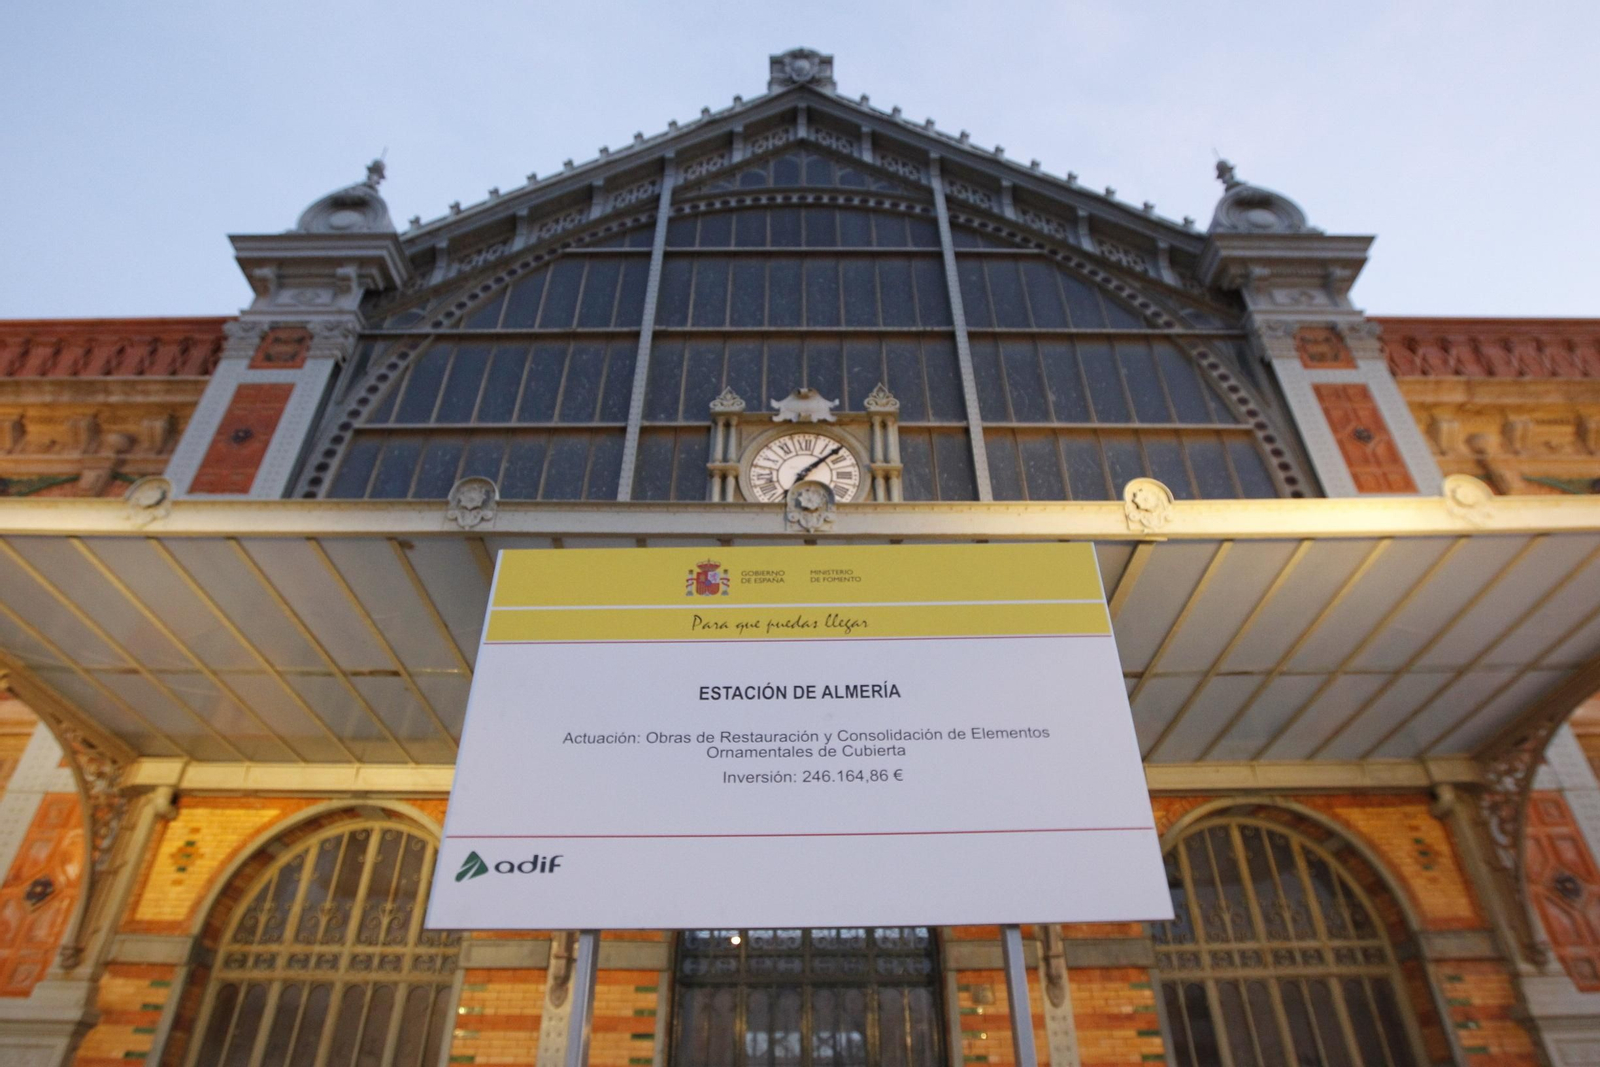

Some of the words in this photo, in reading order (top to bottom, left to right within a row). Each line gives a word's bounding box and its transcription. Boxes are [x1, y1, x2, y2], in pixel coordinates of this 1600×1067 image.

[753, 576, 785, 584] ESPAÑA
[822, 575, 862, 583] FOMENTO
[691, 614, 729, 631] Para
[735, 619, 760, 635] que
[766, 614, 819, 634] puedas
[824, 613, 869, 635] llegar
[699, 682, 788, 701] ESTACIÓN
[793, 684, 817, 700] DE
[821, 680, 902, 699] ALMERÍA
[562, 731, 641, 744] Actuación:
[646, 731, 692, 744] Obras
[696, 731, 716, 744] de
[719, 730, 820, 744] Restauración
[823, 731, 833, 745] y
[837, 727, 944, 742] Consolidación
[947, 727, 967, 740] de
[971, 726, 1051, 740] Elementos
[706, 745, 814, 759] Ornamentales
[817, 745, 838, 758] de
[841, 744, 907, 758] Cubierta
[722, 770, 798, 784] Inversión:
[802, 769, 889, 784] 246.164,86
[893, 768, 904, 782] €
[494, 854, 564, 874] adif
